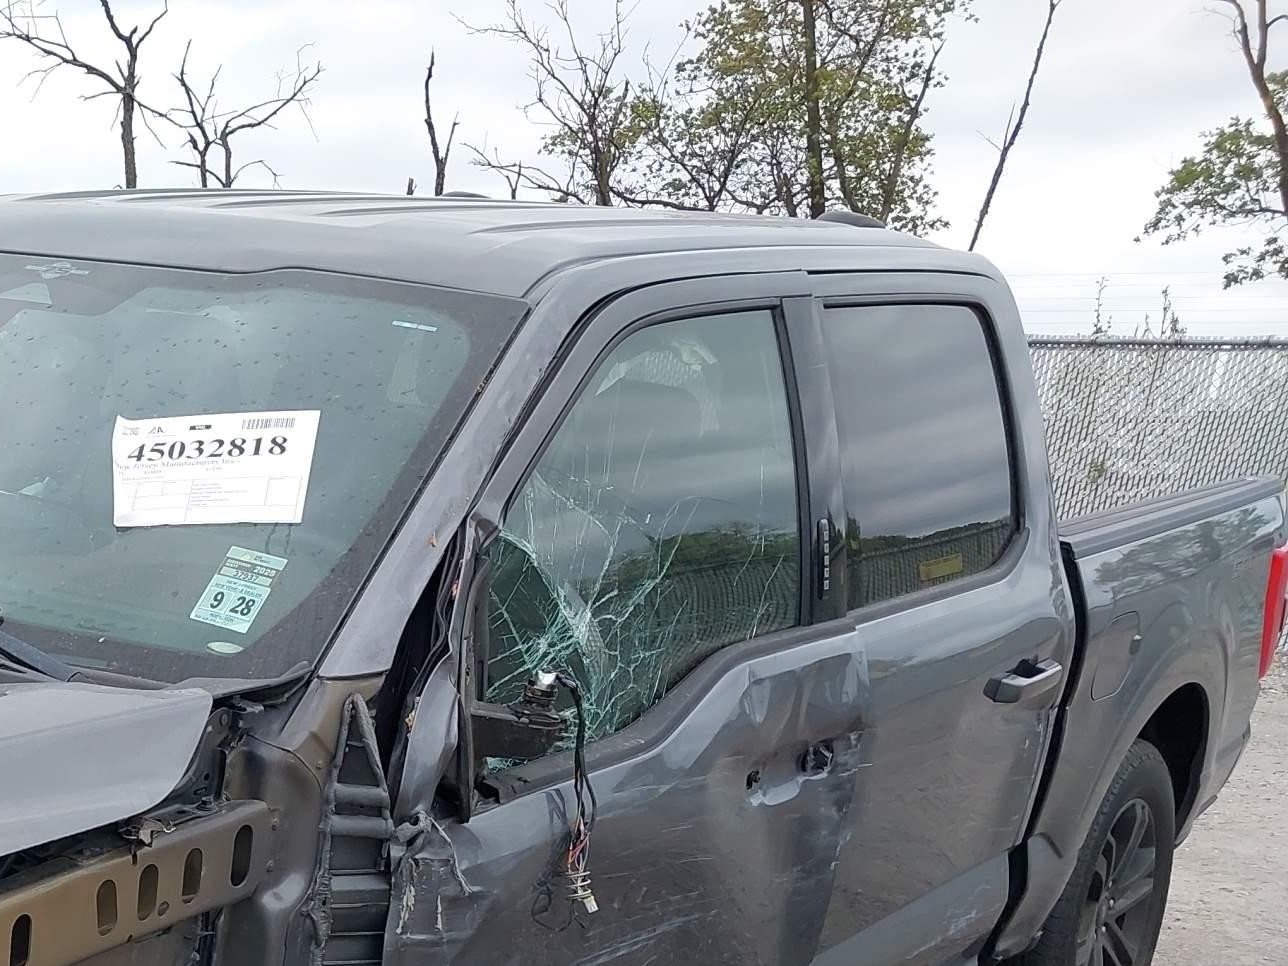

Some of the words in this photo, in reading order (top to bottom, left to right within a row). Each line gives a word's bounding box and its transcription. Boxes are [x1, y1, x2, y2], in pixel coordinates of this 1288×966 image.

[127, 435, 288, 462] 45032818
[209, 591, 225, 609] 9
[229, 596, 256, 617] 28
